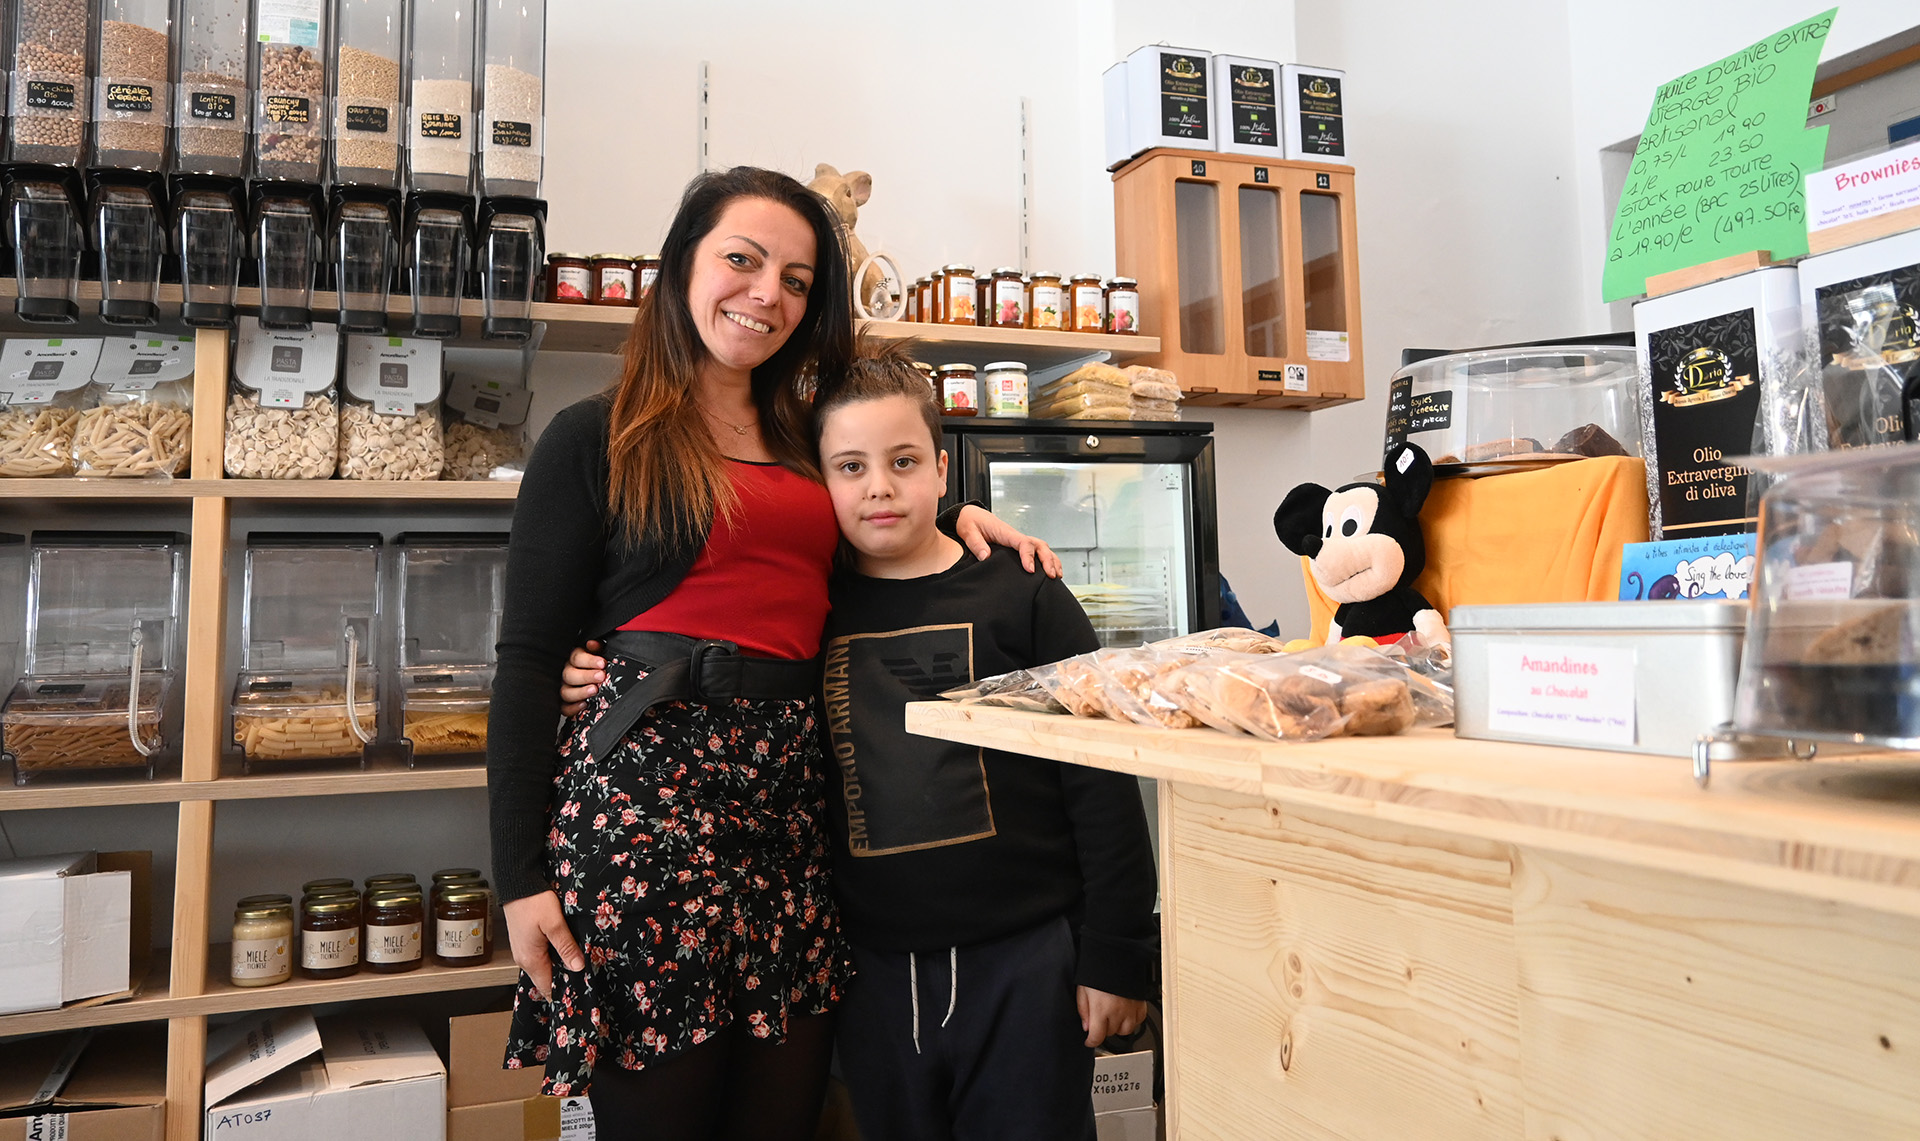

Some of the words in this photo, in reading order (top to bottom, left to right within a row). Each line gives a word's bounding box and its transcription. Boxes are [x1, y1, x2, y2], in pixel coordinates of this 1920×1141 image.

[1713, 112, 1766, 144] 19.90
[1708, 133, 1764, 168] 23.50
[1193, 164, 1204, 174] 10
[1835, 157, 1920, 191] Brownies
[1318, 175, 1328, 186] 12
[1620, 190, 1669, 218] STOCK
[1693, 446, 1722, 464] Olio
[1686, 486, 1699, 502] di
[1702, 483, 1737, 500] oliva
[1685, 566, 1706, 590] Sing
[1710, 566, 1722, 581] the
[1521, 655, 1598, 676] Amandines
[825, 640, 852, 734] ARMANI
[1530, 686, 1542, 696] au
[1546, 684, 1588, 700] Chocolat
[384, 935, 404, 948] MIELE
[445, 930, 463, 942] MIELE
[320, 940, 341, 953] MIELE
[246, 950, 268, 962] MIELE
[216, 1109, 272, 1130] AT037
[562, 1118, 586, 1126] BISCOTTI
